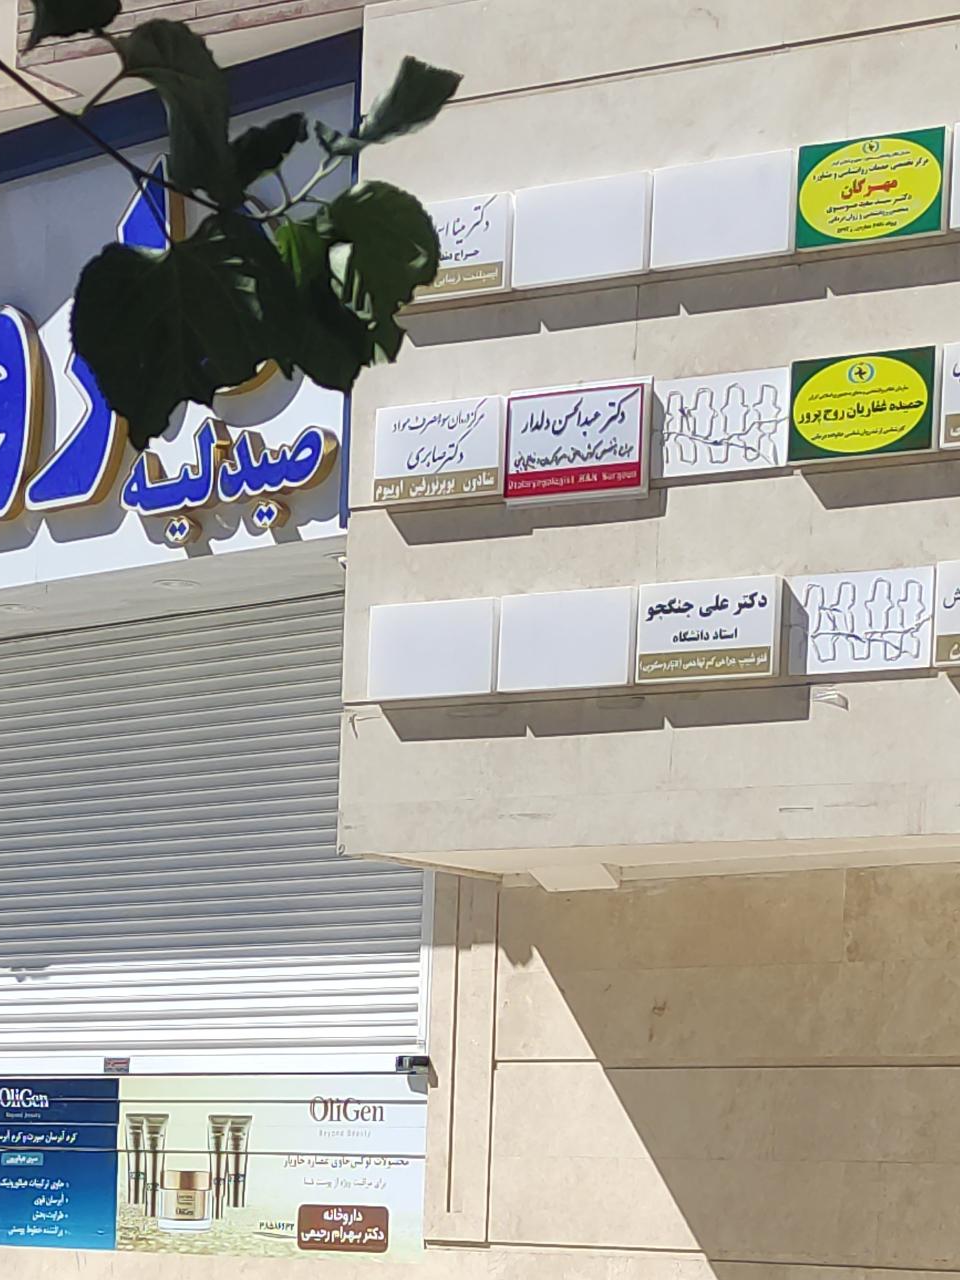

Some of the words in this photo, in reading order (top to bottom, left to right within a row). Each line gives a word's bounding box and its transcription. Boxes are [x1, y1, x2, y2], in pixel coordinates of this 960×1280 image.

[841, 178, 898, 200] مهرگان
[465, 194, 498, 240] دکتر
[599, 388, 640, 434] دکتر
[889, 399, 925, 414] حمیده
[521, 409, 551, 434] دلدار
[407, 445, 447, 471] صابری
[434, 428, 473, 474] دکتر
[121, 417, 332, 544] صیدلیه
[645, 597, 694, 622] جنگجو
[698, 594, 730, 618] علی
[732, 591, 768, 616] دکتر
[672, 630, 710, 643] دانشگاه
[713, 627, 738, 641] استاد
[309, 1096, 385, 1122] OliGen
[323, 1207, 363, 1225] داروخانه
[301, 1229, 331, 1243] رحیمی
[331, 1226, 362, 1244] بهرام
[363, 1227, 385, 1243] دکتر
